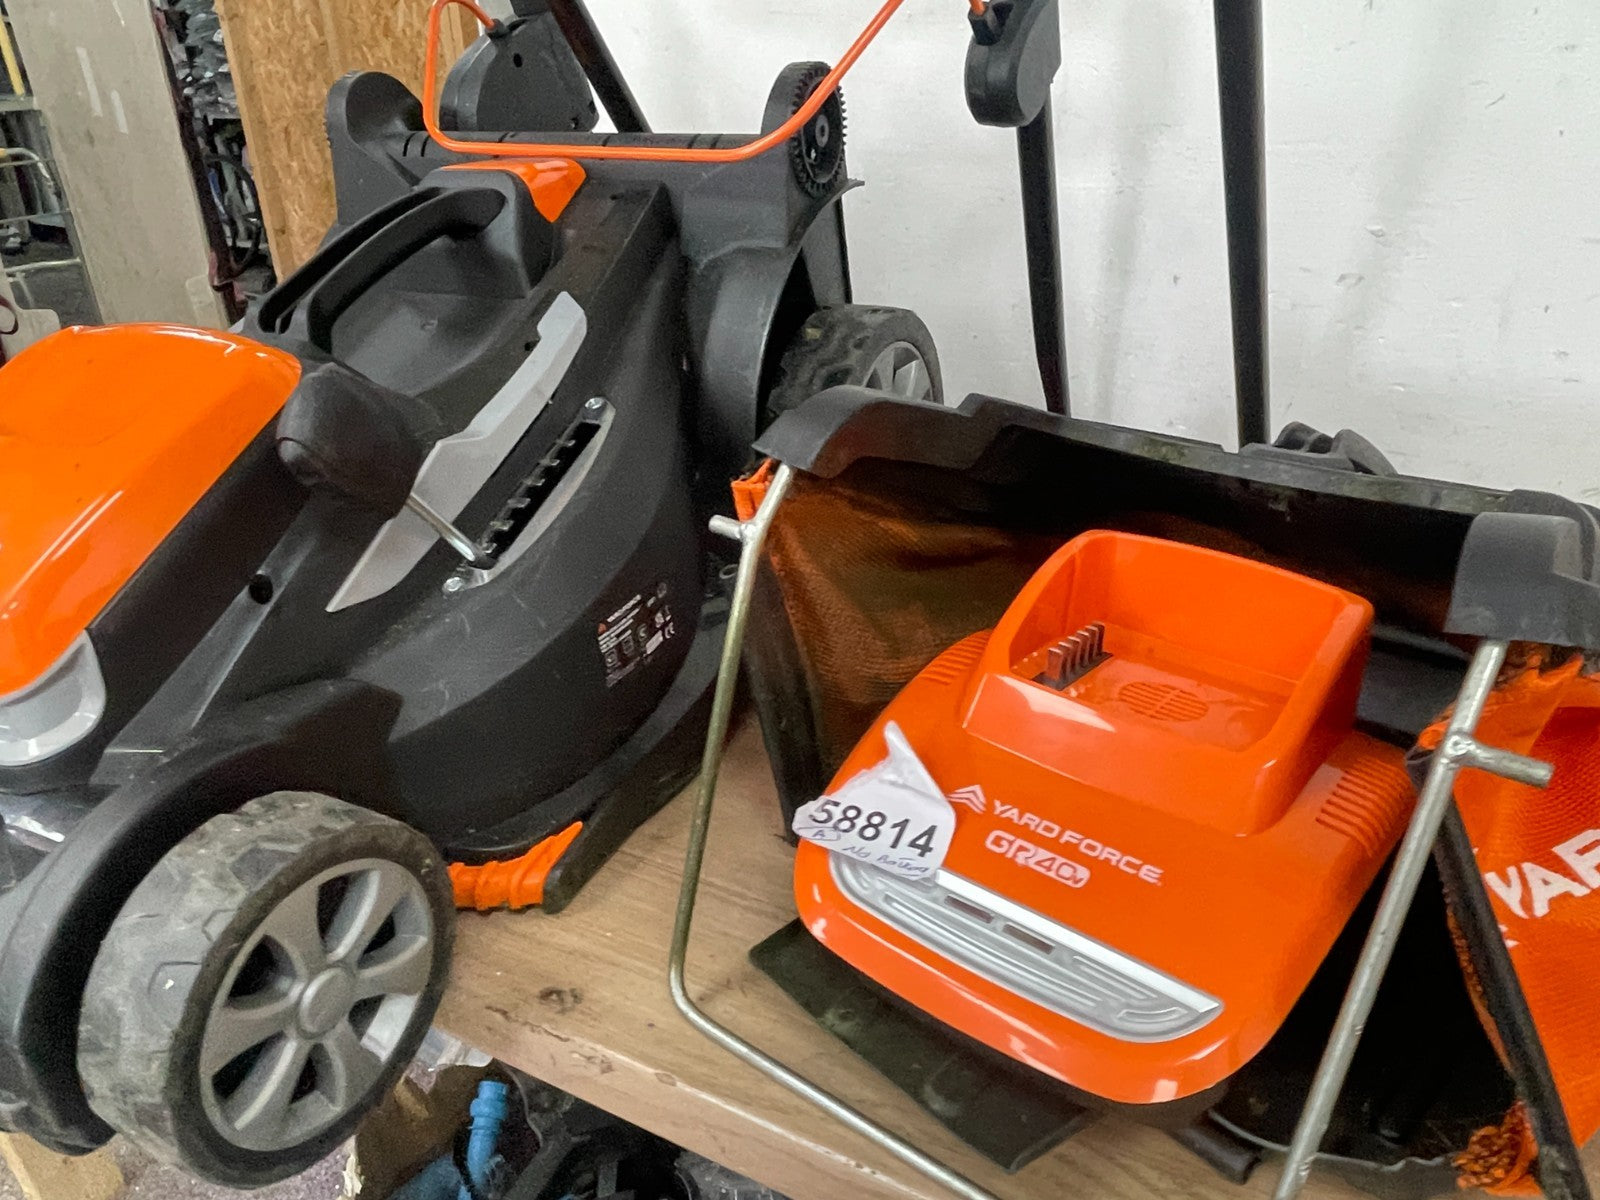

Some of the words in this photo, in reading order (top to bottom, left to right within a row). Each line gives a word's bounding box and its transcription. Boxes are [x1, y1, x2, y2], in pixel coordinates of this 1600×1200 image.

[808, 800, 937, 858] 58814
[993, 799, 1061, 838] YARD
[1059, 829, 1164, 885] FORCE
